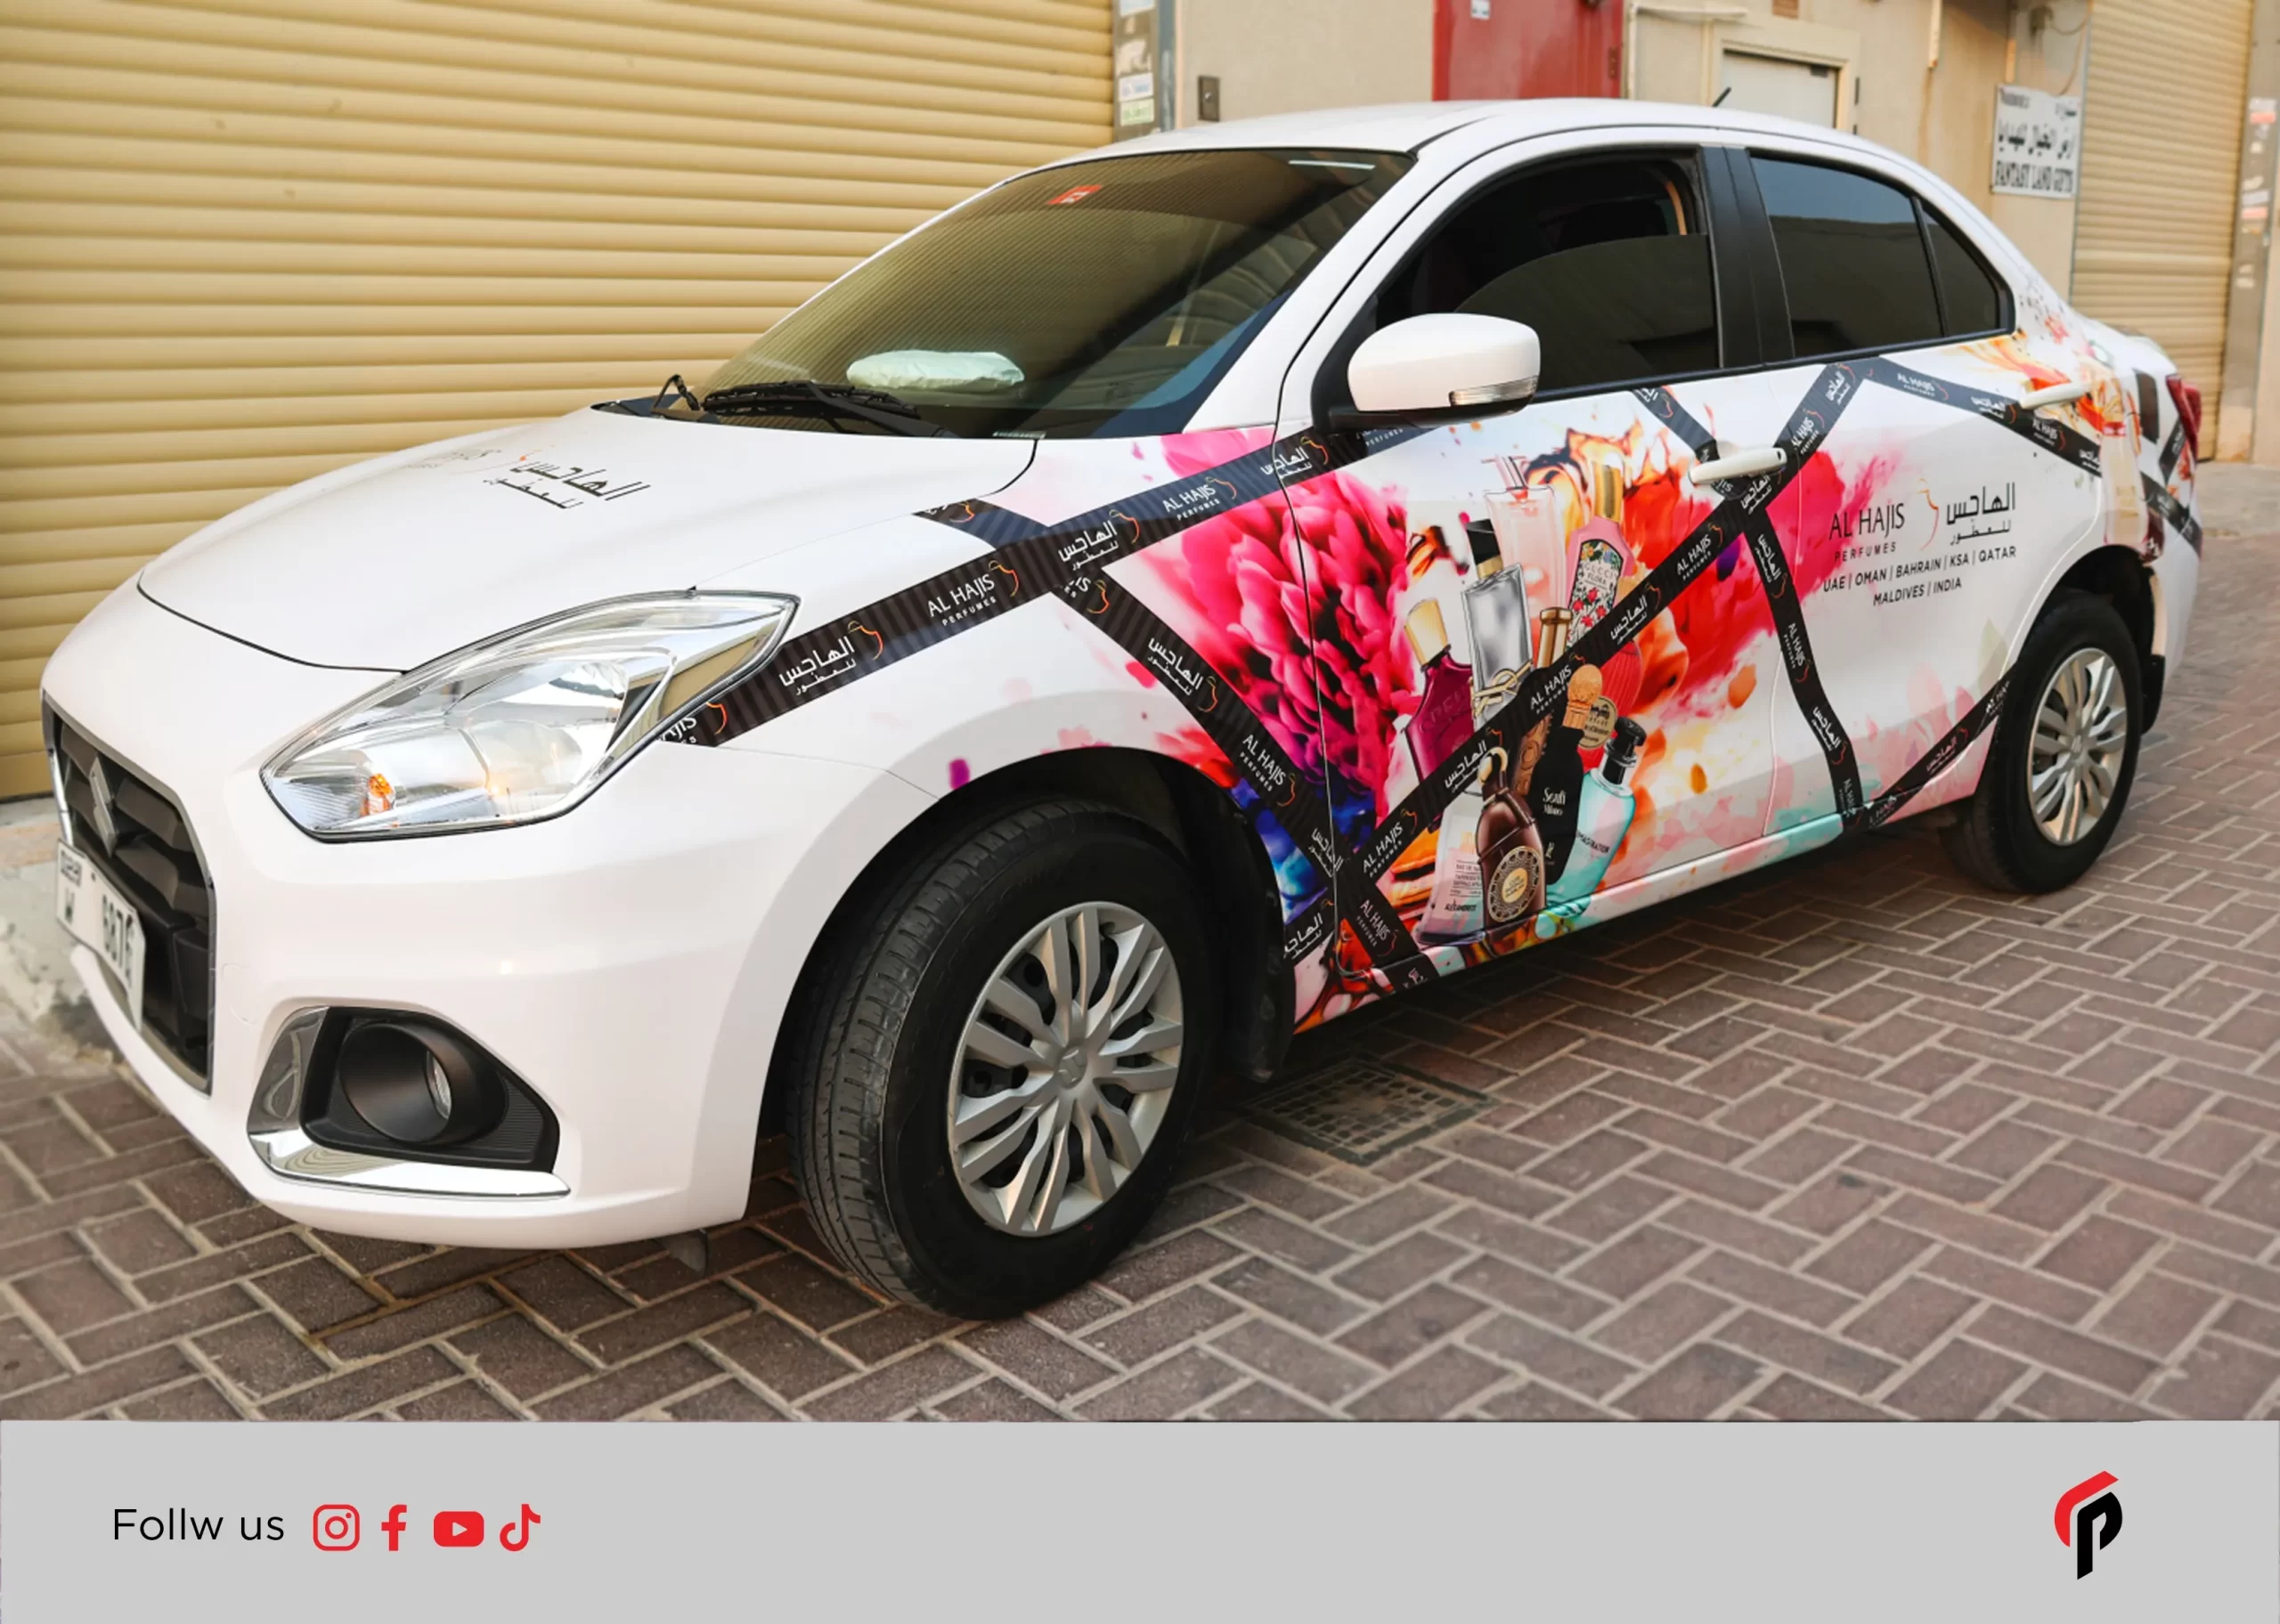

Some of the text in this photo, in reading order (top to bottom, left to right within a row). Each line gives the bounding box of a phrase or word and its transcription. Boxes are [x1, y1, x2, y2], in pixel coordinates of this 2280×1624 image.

[1162, 483, 1217, 512] AL HAJIS
[1177, 499, 1221, 521] PERFUMES
[1946, 482, 2016, 525] الهاجس
[1828, 502, 1906, 540] AL HAJIS
[1057, 519, 1120, 564] الهاجس
[1835, 541, 1897, 564] PERFUMES
[1823, 545, 2017, 593] UAE OMAN BAHRAIN KSA QATAR
[927, 573, 997, 618] AL HAJIS
[1873, 577, 1962, 606] MALDIVES INDIA
[941, 595, 998, 627] PERFUMES
[778, 635, 856, 688] الهاجس
[662, 716, 697, 742] AJIS
[1242, 733, 1258, 755] AL
